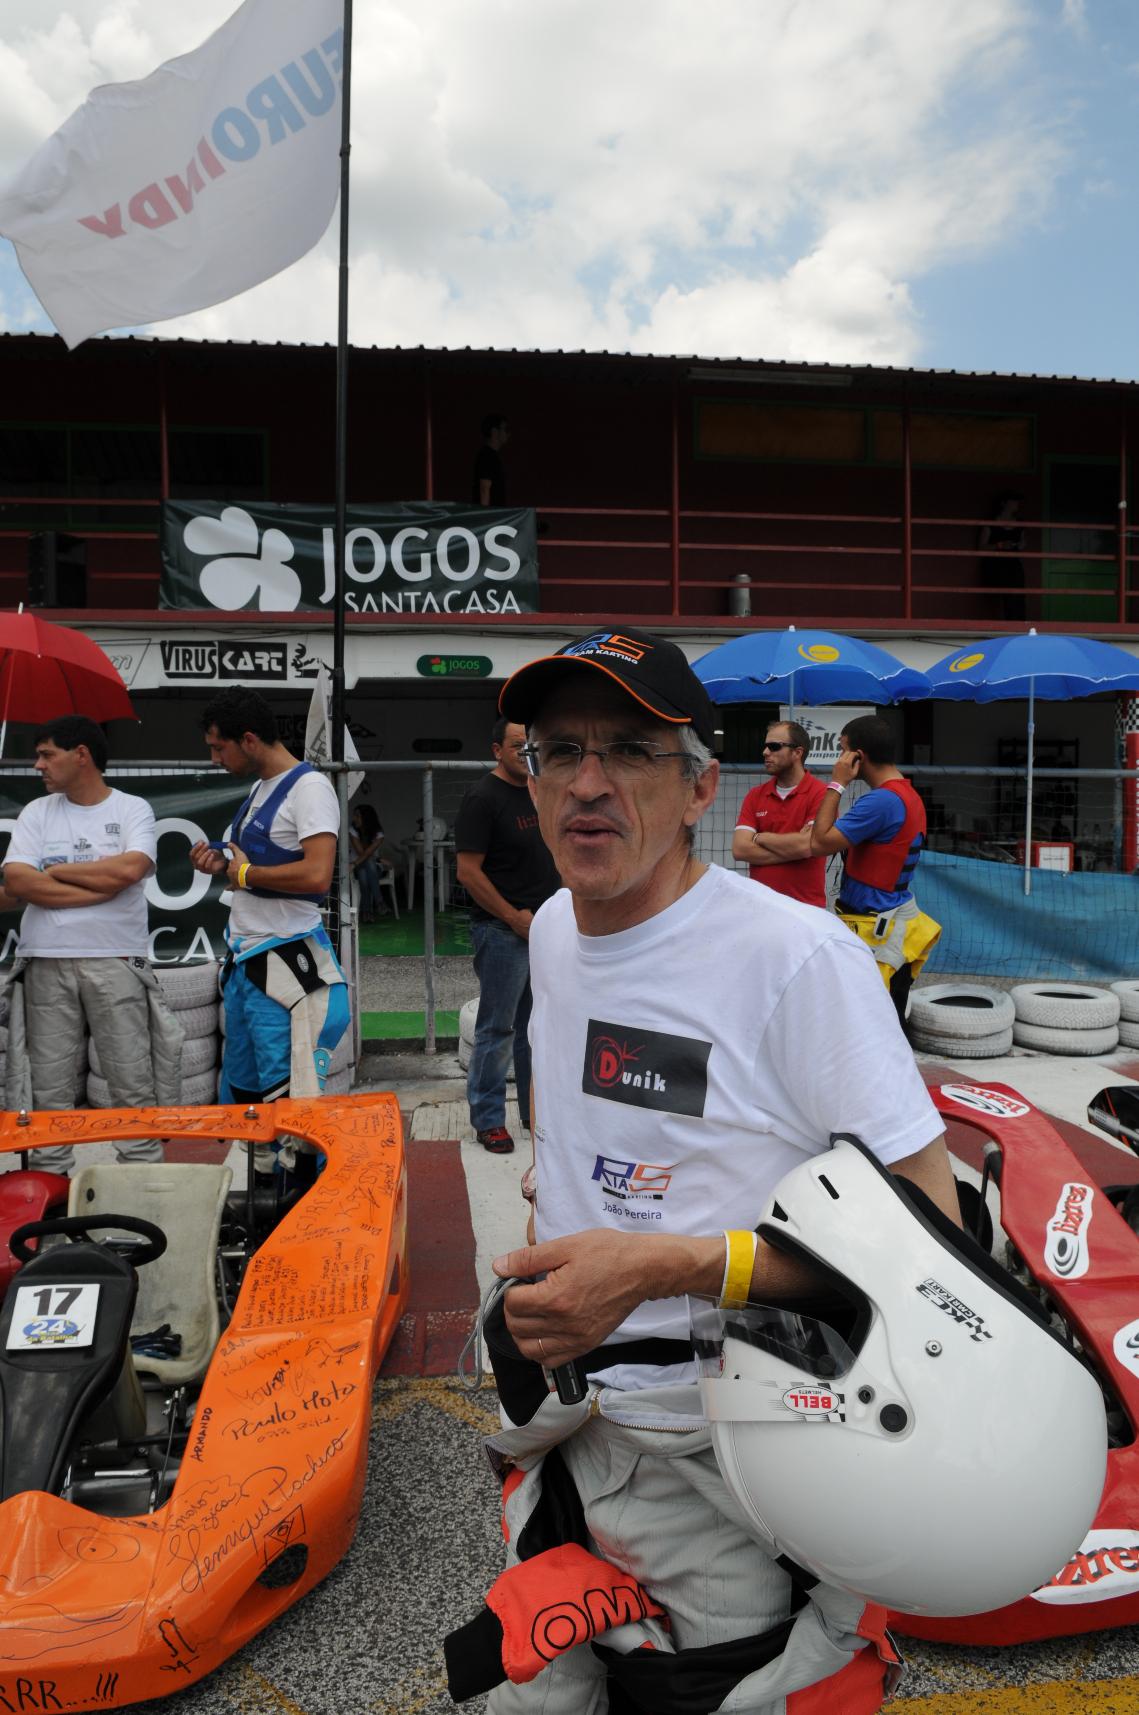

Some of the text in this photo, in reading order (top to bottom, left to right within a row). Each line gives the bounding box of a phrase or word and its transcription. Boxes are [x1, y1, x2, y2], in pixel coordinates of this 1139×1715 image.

[318, 525, 521, 604] JOGOS
[160, 640, 218, 679] VIRUS
[222, 650, 283, 672] KART
[448, 659, 480, 673] JOGOS
[595, 649, 638, 665] KARTING
[600, 1050, 666, 1093] Dunik
[602, 1201, 663, 1220] João Pereira
[33, 1287, 84, 1316] 17
[928, 1281, 953, 1300] KART
[30, 1319, 67, 1336] 24
[789, 1394, 832, 1409] BELL
[190, 1406, 214, 1463] ARMANDO
[531, 1583, 649, 1663] OM
